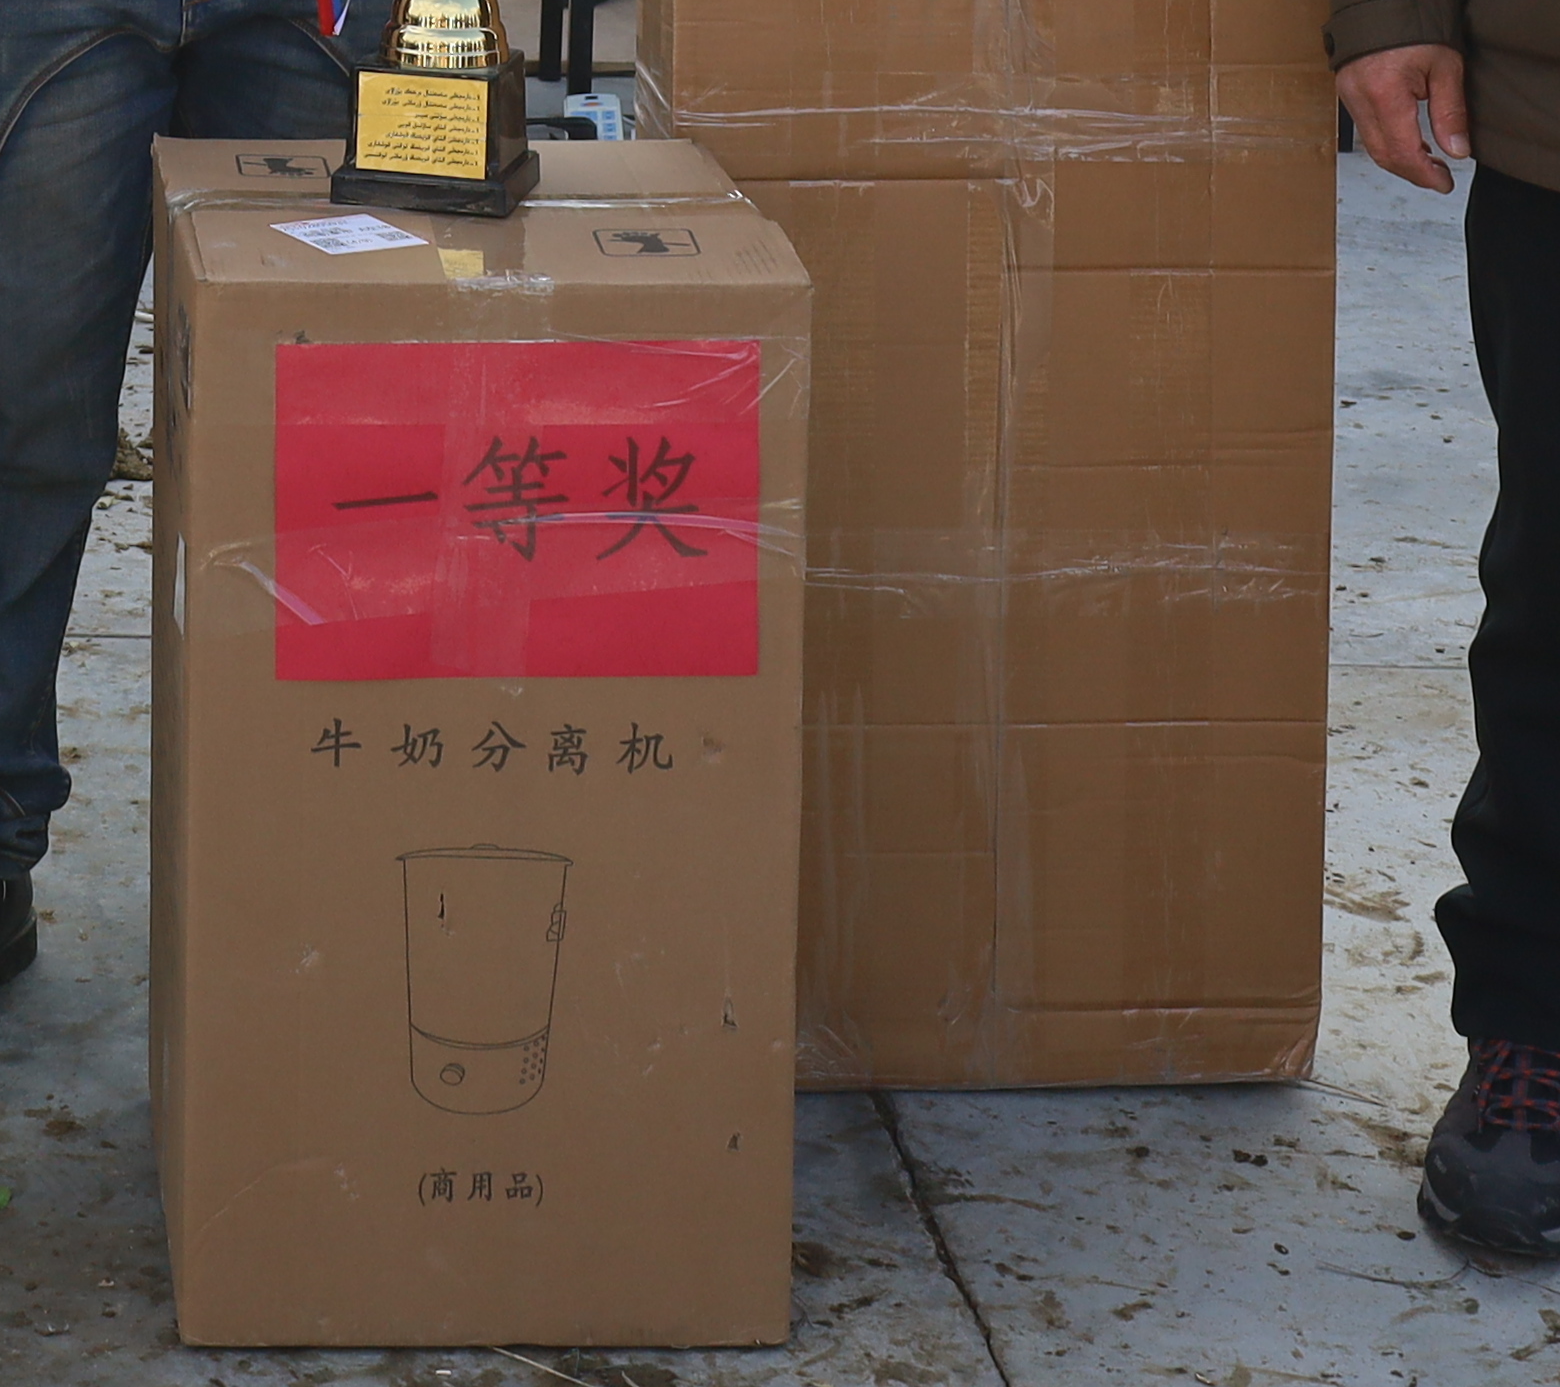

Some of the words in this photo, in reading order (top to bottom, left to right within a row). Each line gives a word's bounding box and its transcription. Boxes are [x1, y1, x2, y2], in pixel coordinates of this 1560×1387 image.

[330, 433, 710, 563] 一等奖
[310, 715, 675, 776] 牛奶分离机
[417, 1166, 546, 1207] (商用品)
